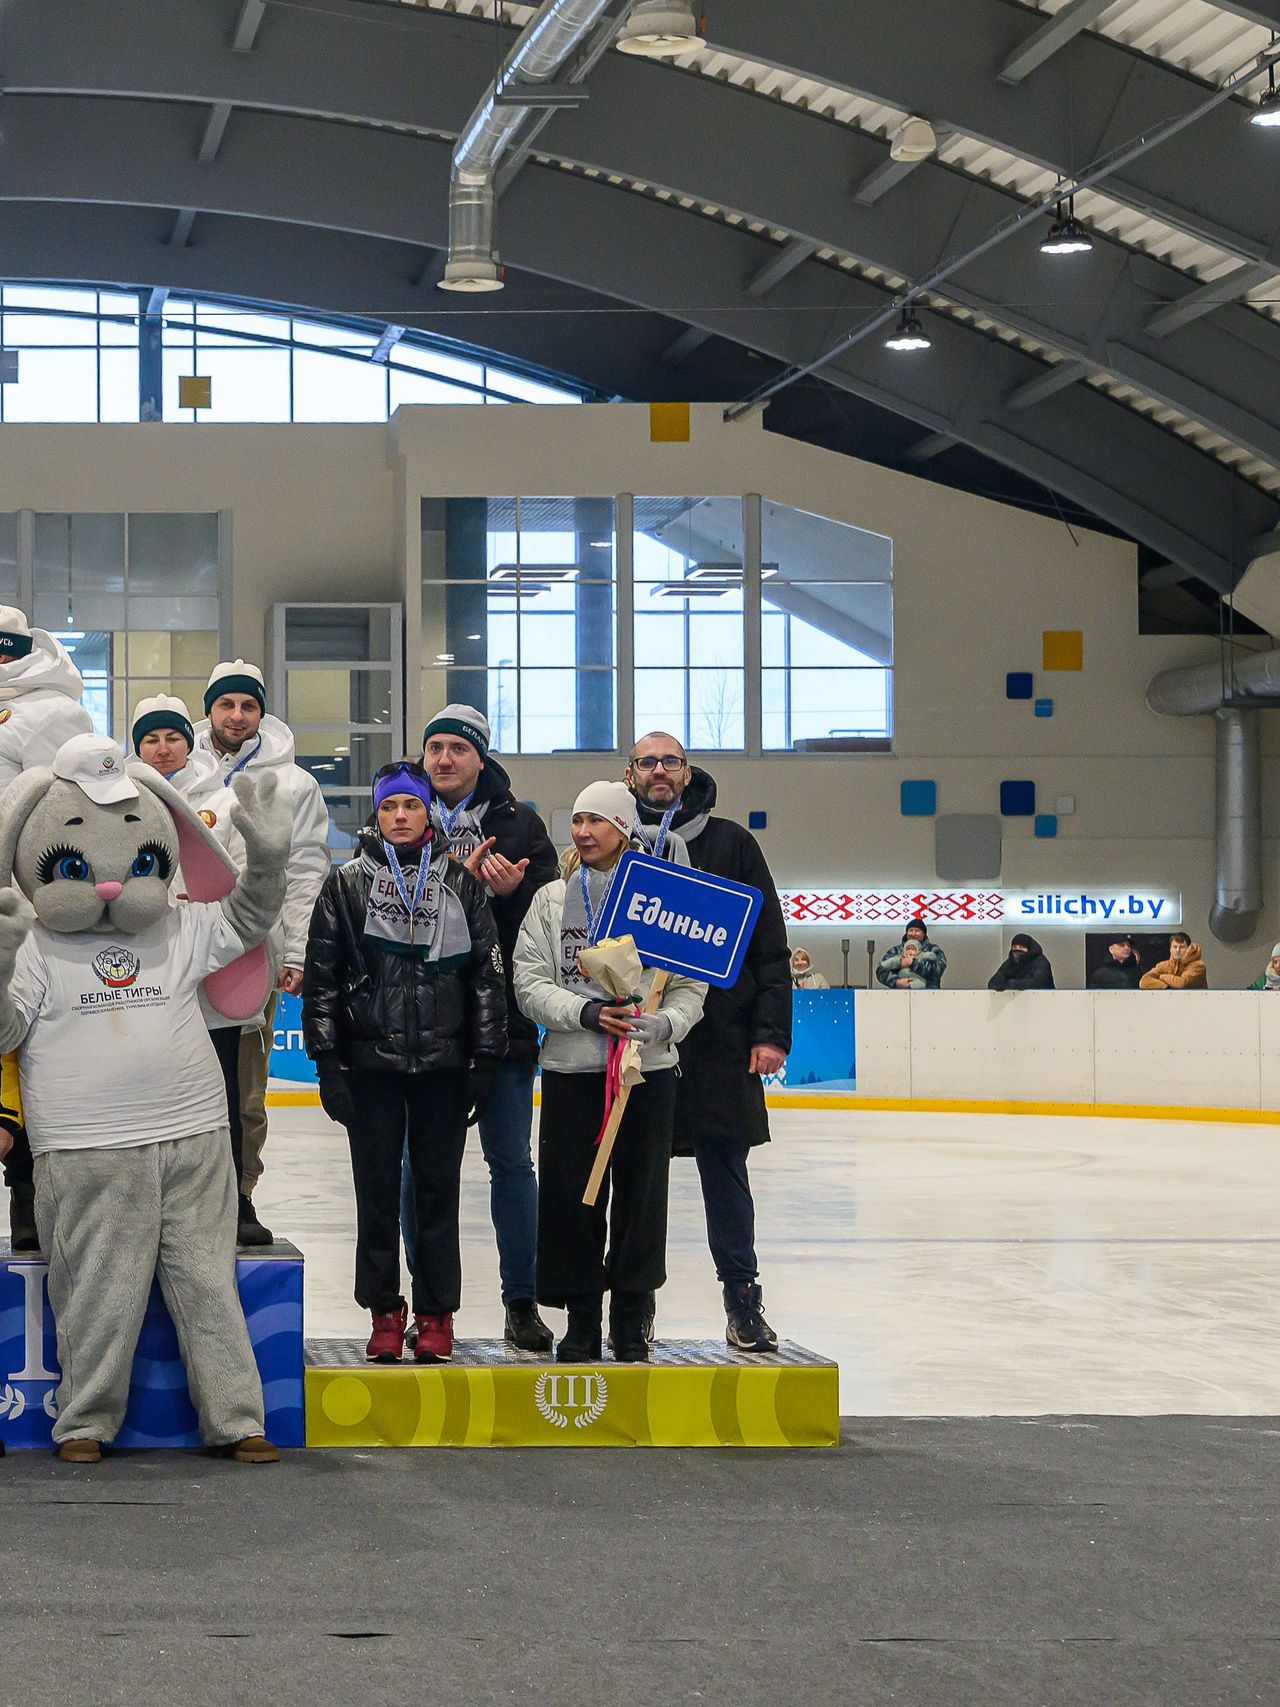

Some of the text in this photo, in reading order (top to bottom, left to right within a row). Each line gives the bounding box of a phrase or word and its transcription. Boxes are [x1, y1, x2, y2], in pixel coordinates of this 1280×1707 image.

[626, 892, 728, 947] Единые
[1021, 895, 1165, 919] silichy.by
[80, 986, 162, 1004] БЕЛЫЕ ТИГРЫ
[547, 1375, 596, 1407] III
